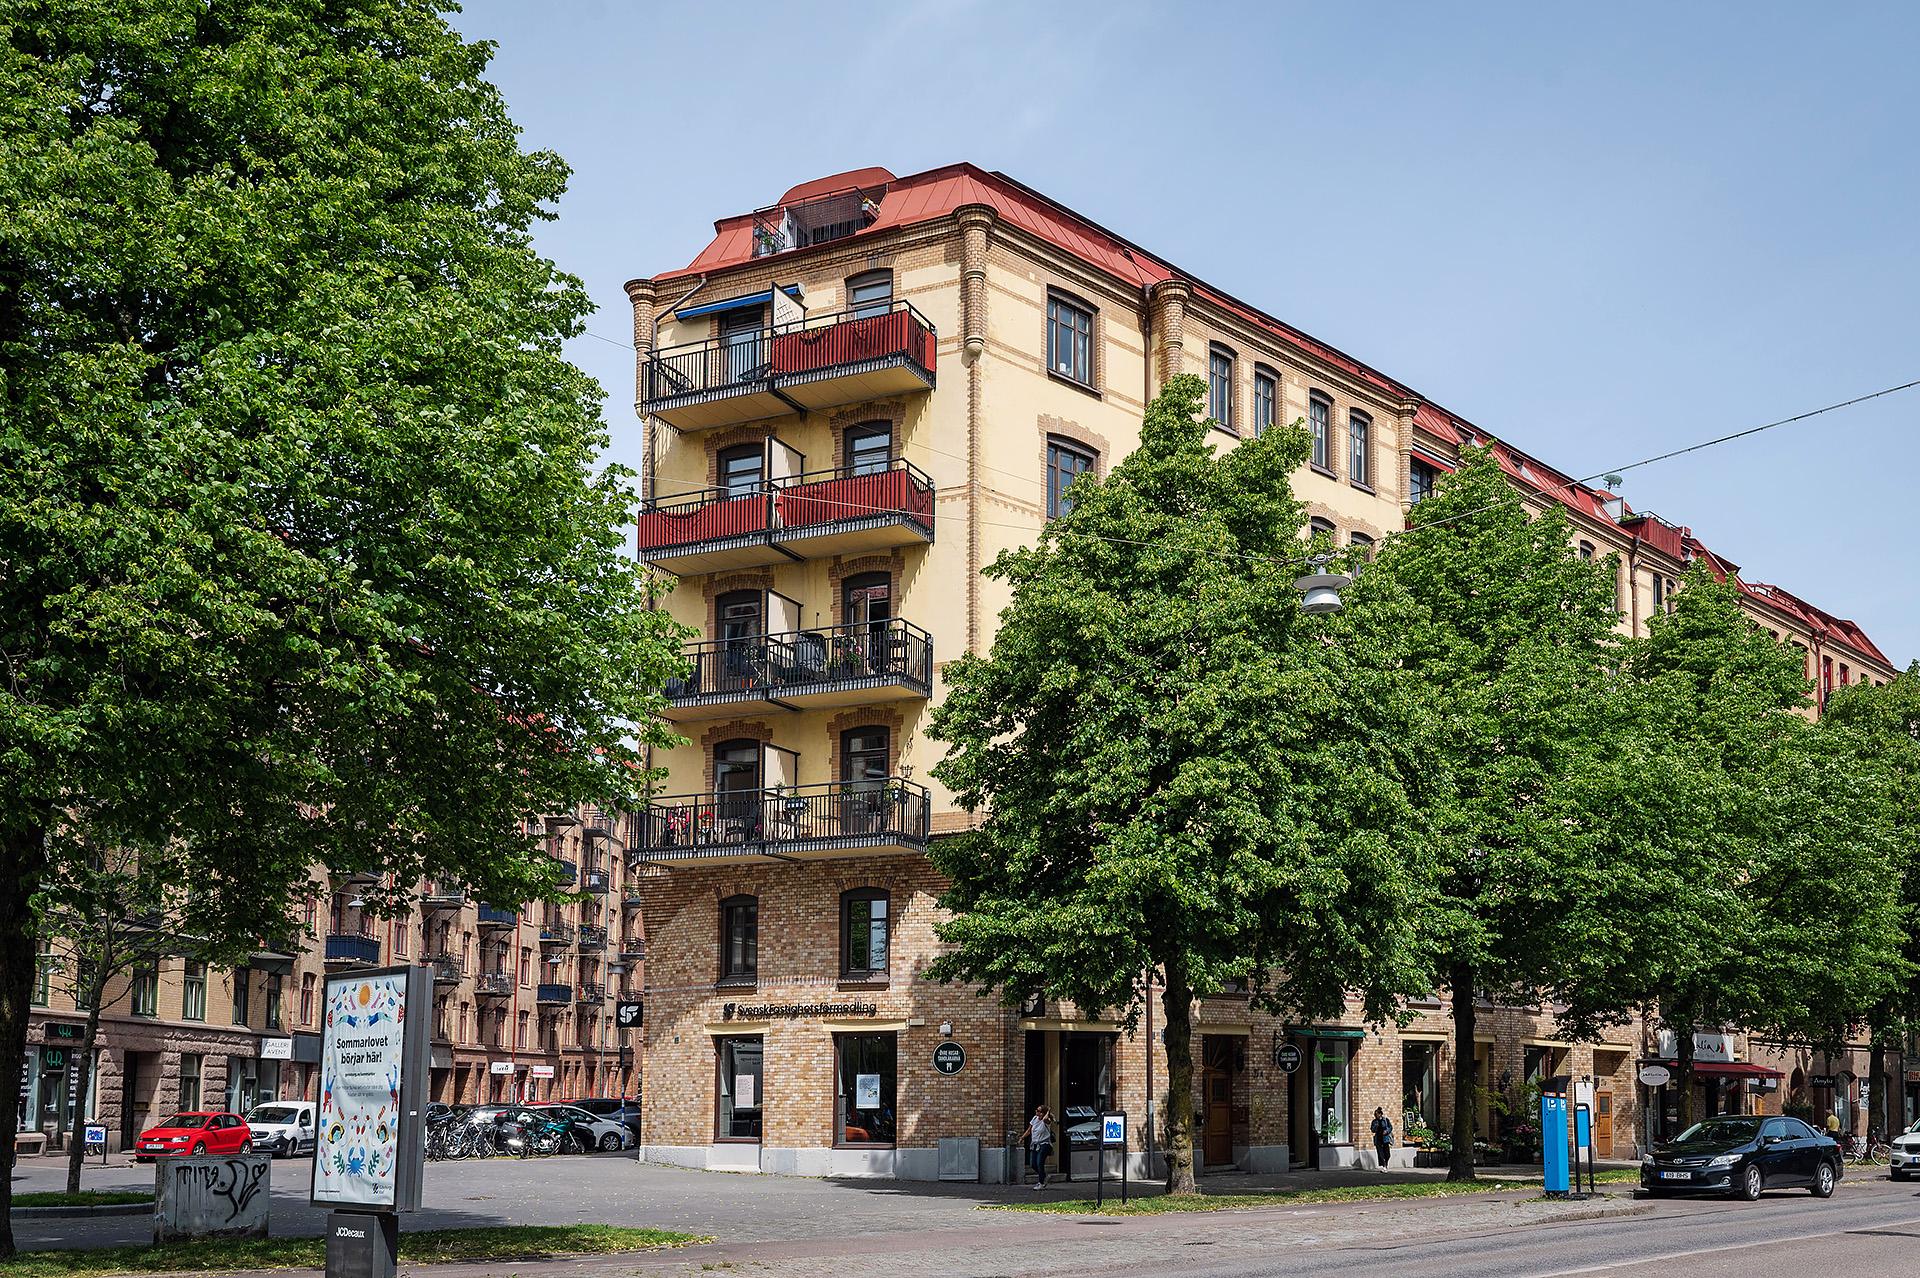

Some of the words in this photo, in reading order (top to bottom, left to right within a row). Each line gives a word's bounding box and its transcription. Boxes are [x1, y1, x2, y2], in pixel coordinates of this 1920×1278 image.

[336, 1036, 388, 1049] Sommarlovet
[341, 1052, 364, 1066] börjar
[366, 1051, 382, 1063] här!
[336, 1227, 365, 1238] JCDecaux
